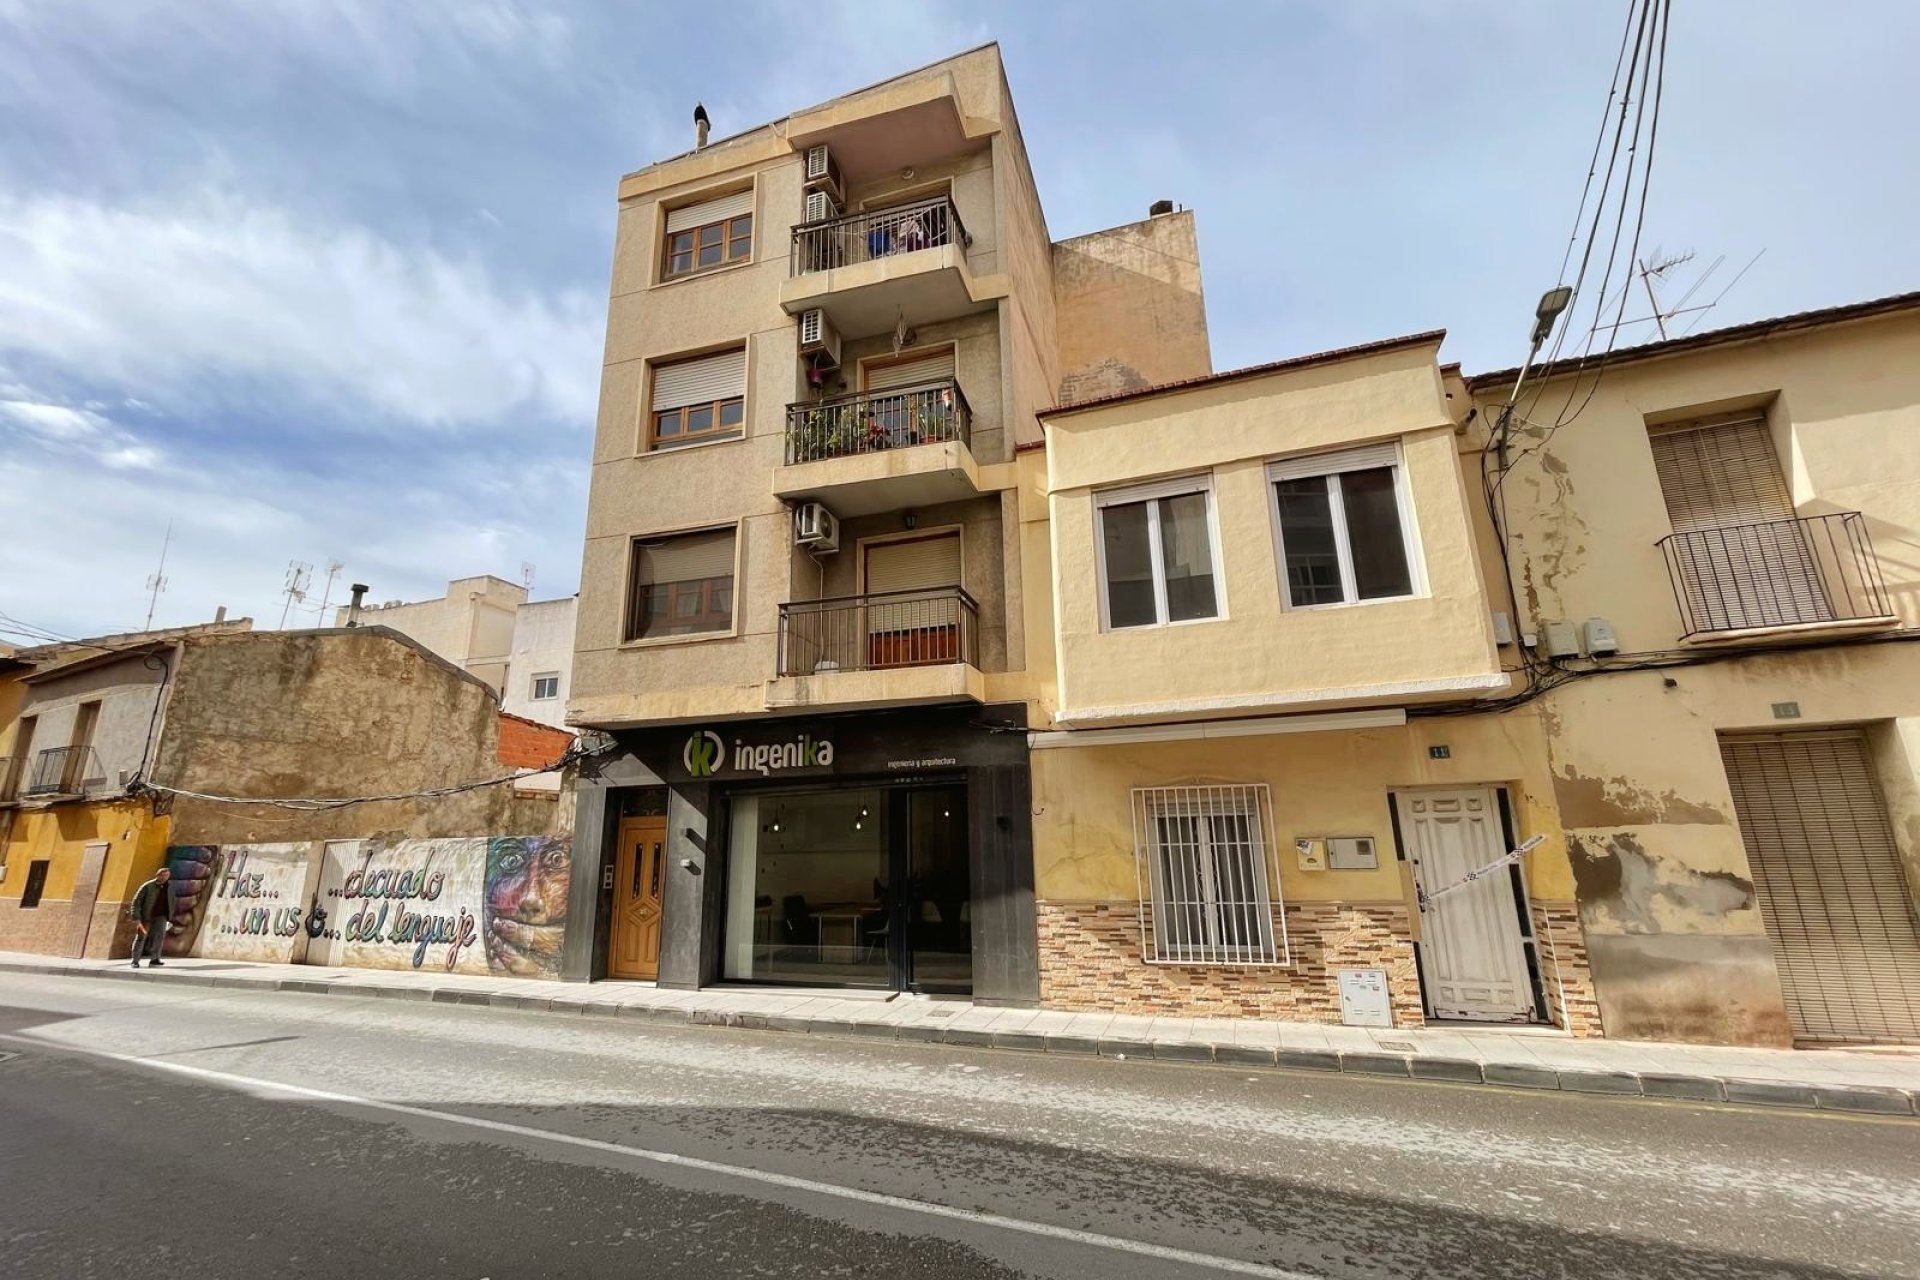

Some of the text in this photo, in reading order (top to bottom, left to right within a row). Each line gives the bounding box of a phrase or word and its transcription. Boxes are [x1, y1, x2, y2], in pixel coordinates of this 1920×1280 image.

[734, 734, 834, 776] ingenika
[346, 899, 478, 972] del lenguaje
